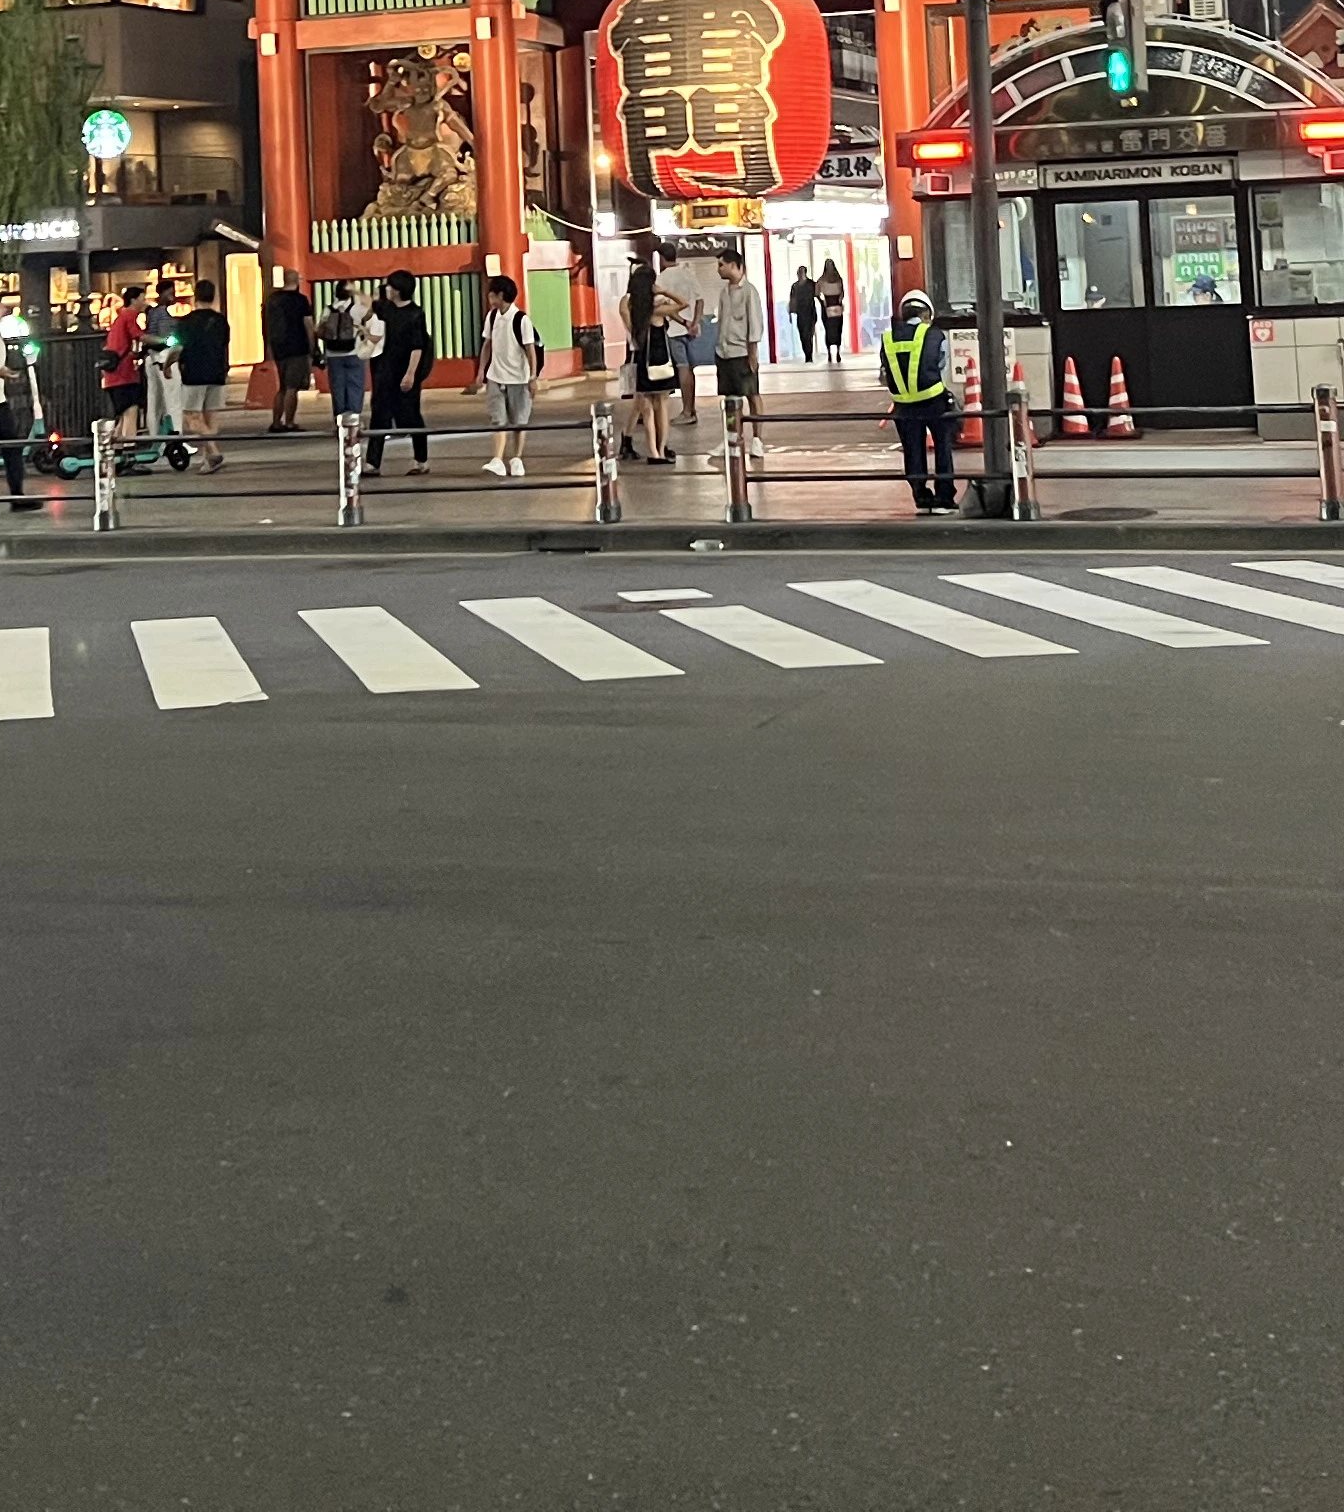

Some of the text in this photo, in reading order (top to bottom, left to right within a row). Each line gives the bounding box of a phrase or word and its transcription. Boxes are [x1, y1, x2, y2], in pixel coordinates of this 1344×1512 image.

[1119, 125, 1227, 153] 雷門交番
[1054, 165, 1163, 183] KAMINARIMON
[1170, 162, 1224, 178] KOBAN
